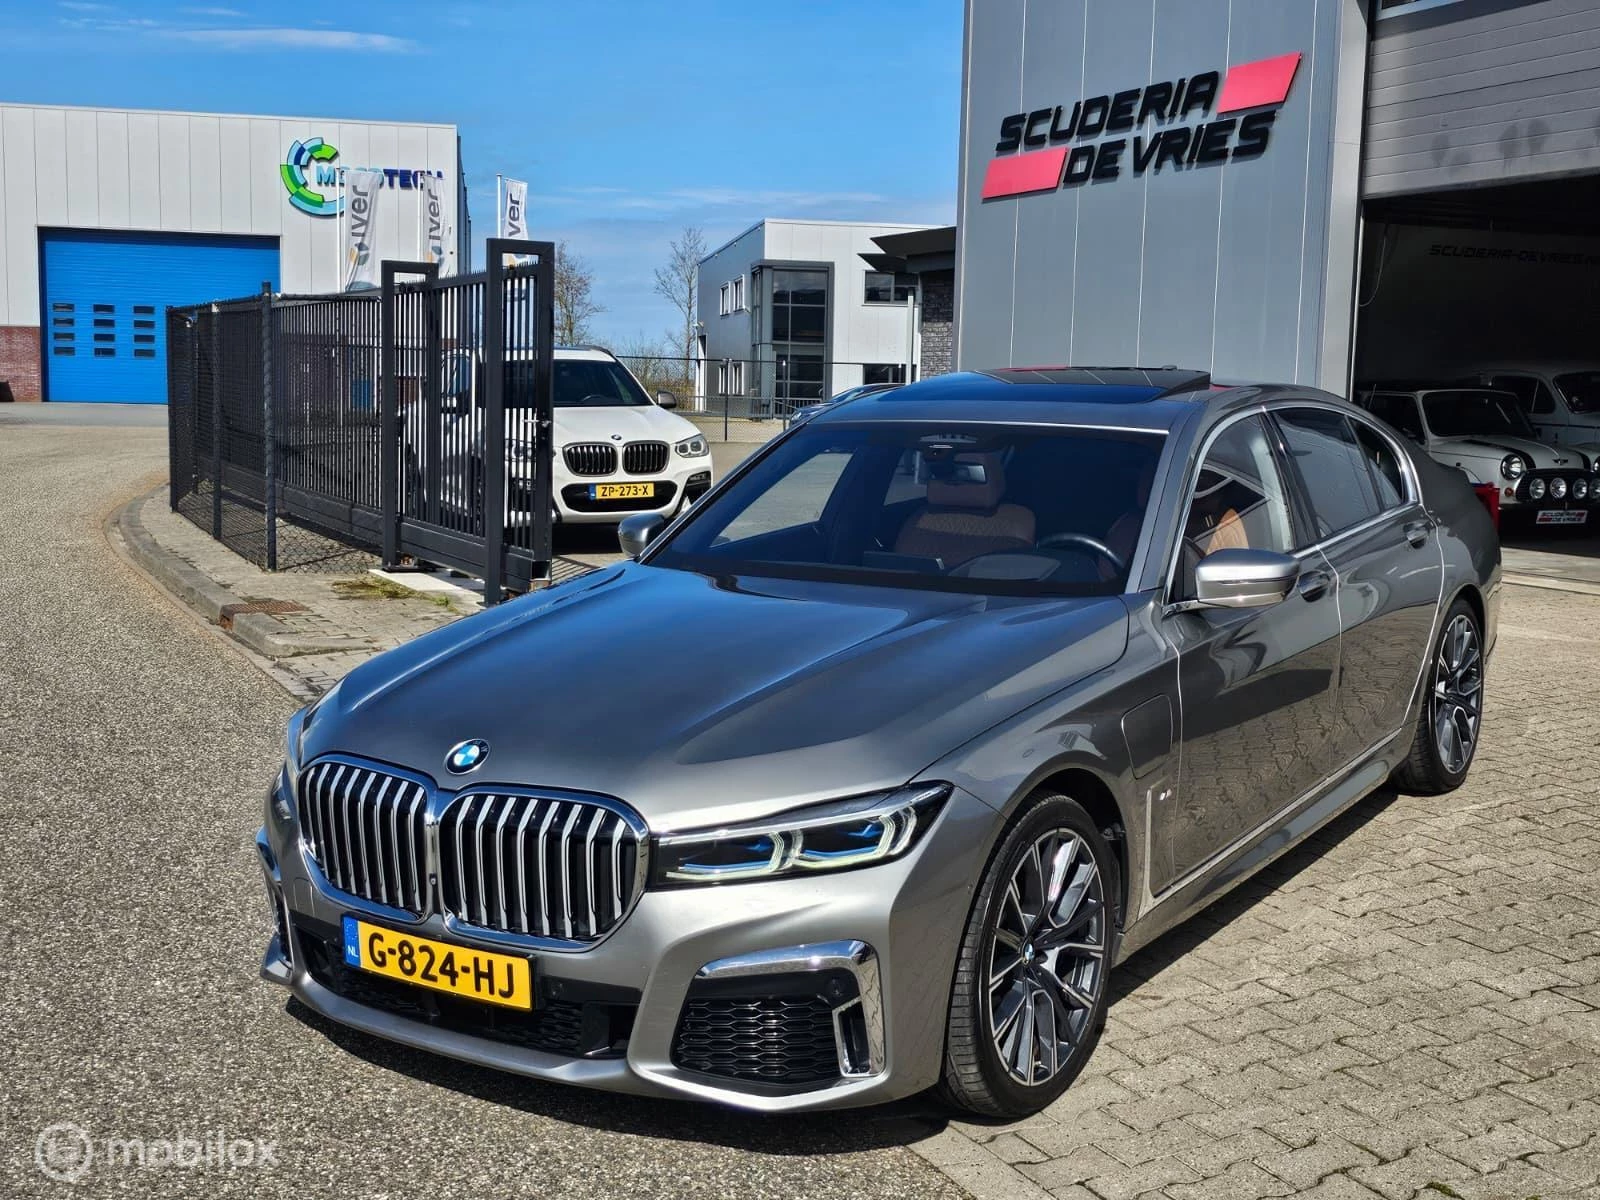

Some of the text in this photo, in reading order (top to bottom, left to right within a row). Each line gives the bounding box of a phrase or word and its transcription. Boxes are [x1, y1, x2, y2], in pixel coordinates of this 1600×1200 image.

[995, 71, 1220, 152] SCUDERIA
[1063, 110, 1277, 184] DE VRIES
[600, 486, 649, 498] ZP-273-X
[368, 931, 515, 999] G-824-HJ
